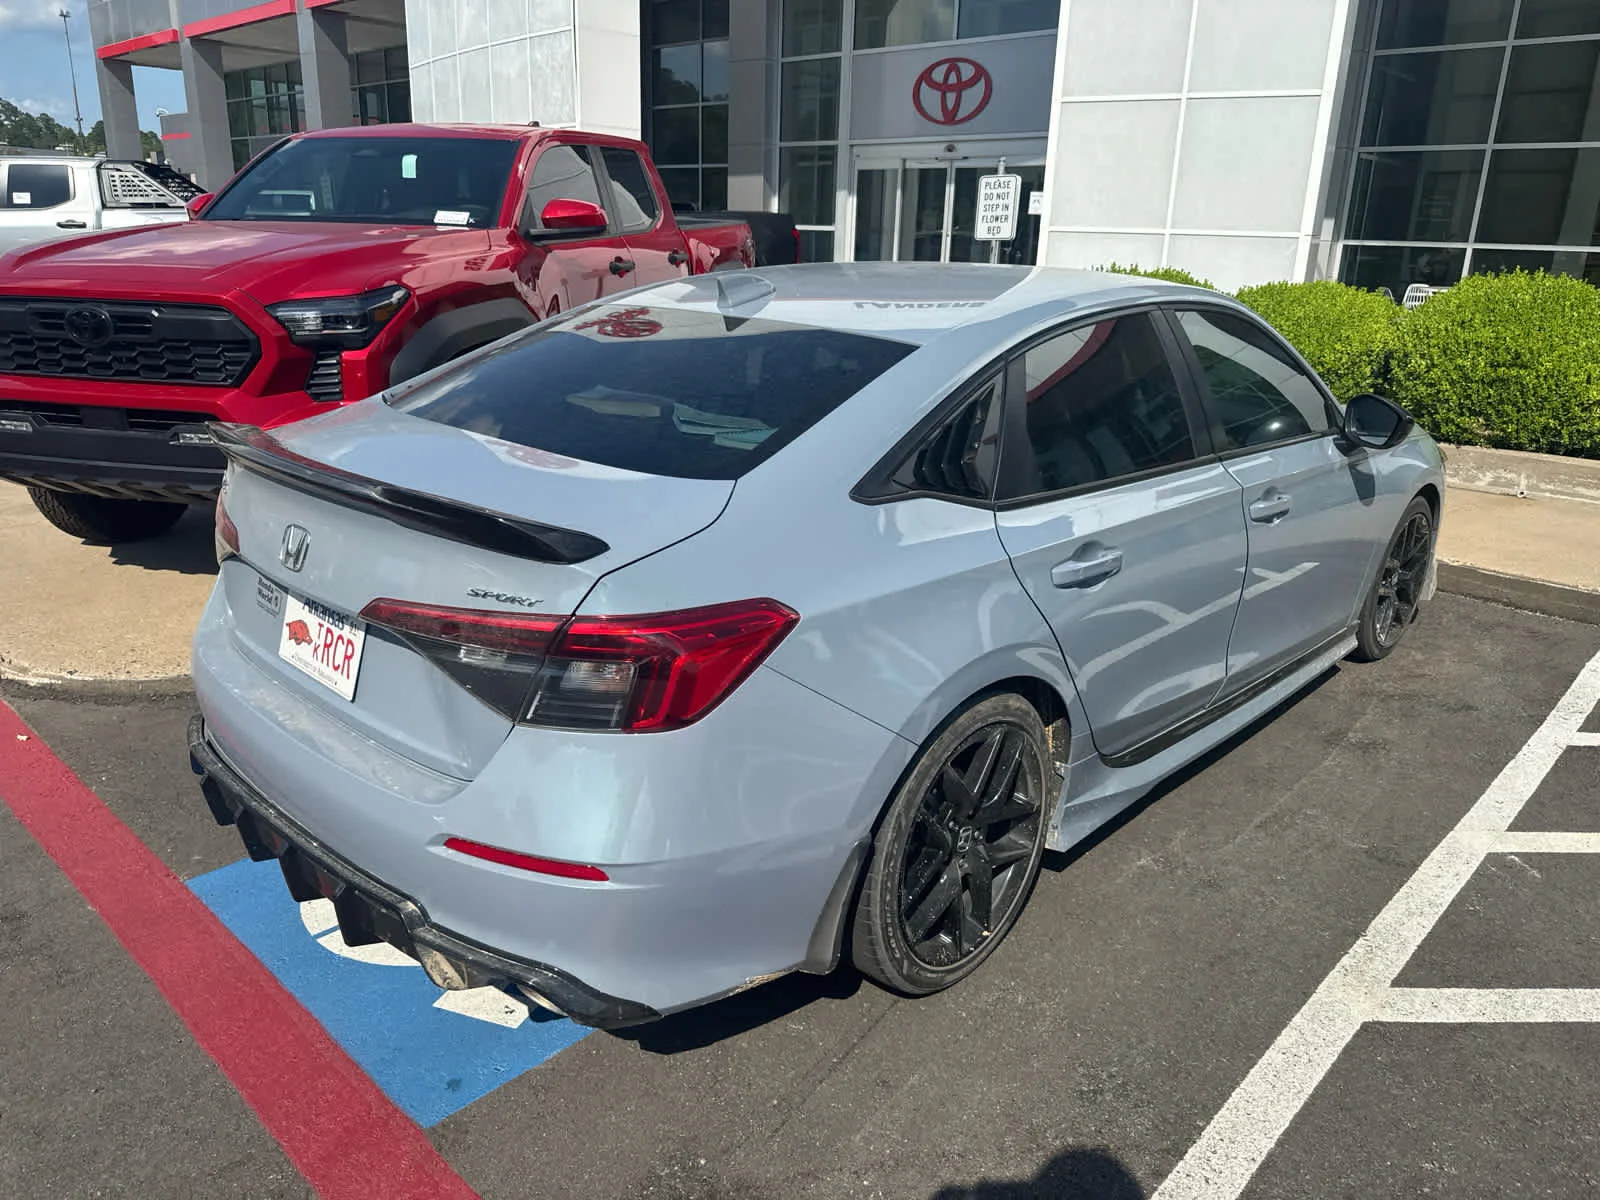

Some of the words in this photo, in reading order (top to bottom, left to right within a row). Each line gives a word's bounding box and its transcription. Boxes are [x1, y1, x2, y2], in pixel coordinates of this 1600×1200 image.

[984, 180, 1011, 190] PLEASE
[984, 192, 994, 201] DO
[996, 191, 1010, 200] NOT
[983, 203, 1000, 213] STEP
[1001, 203, 1009, 212] IN
[981, 214, 1009, 224] FLOWER
[987, 226, 1001, 235] BED
[466, 588, 544, 607] SPORT
[321, 626, 355, 680] RCR
